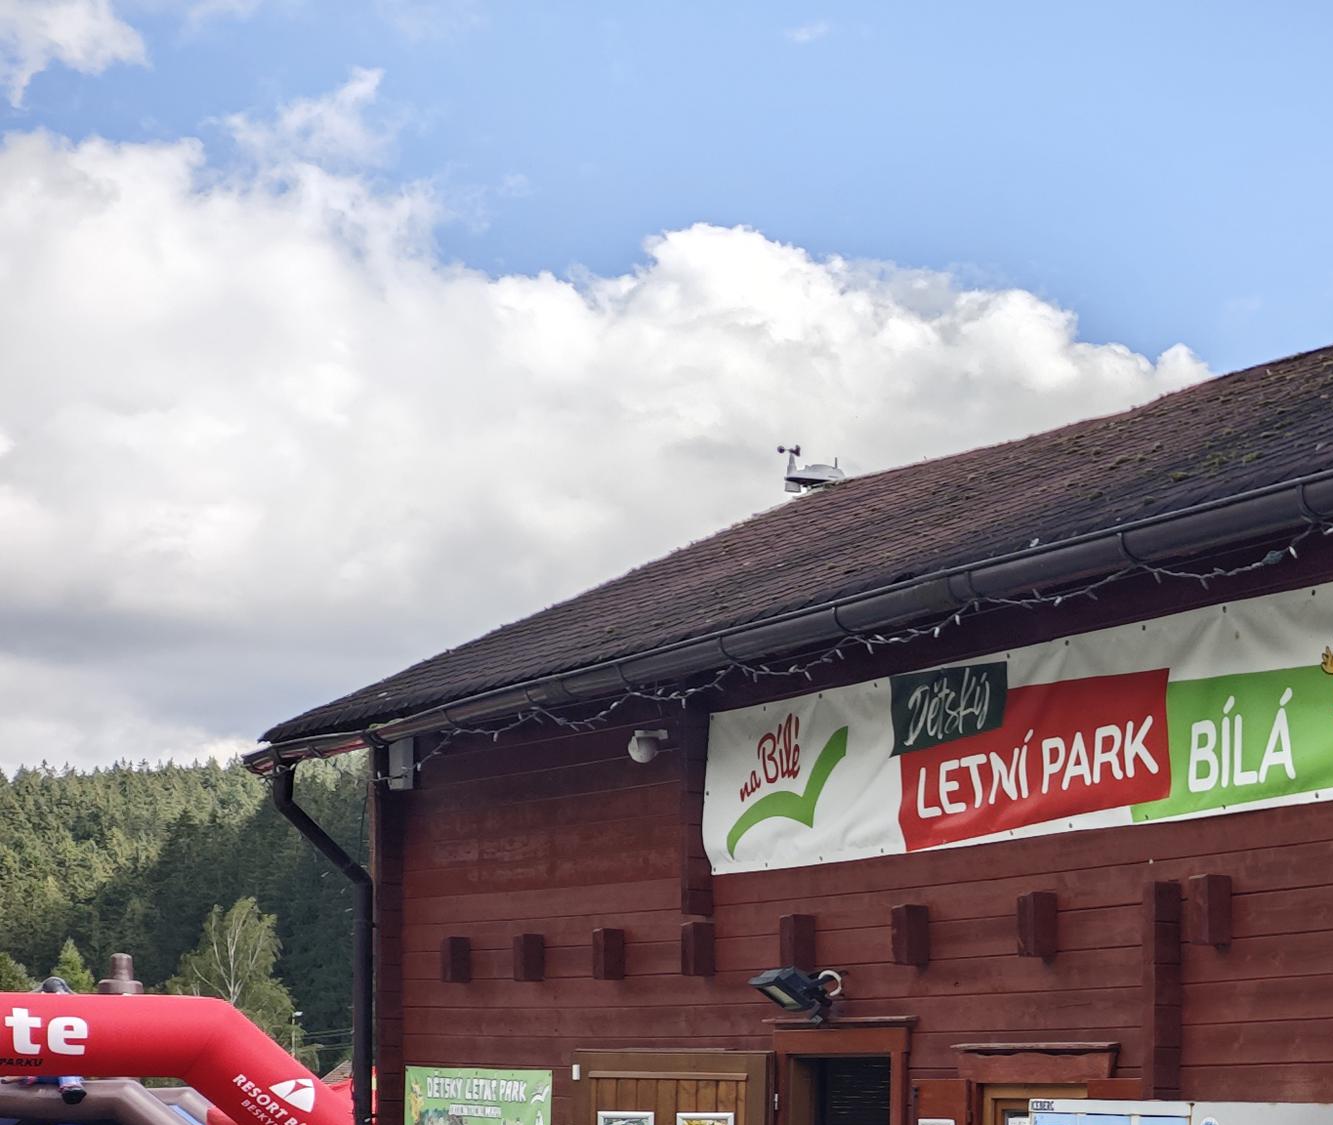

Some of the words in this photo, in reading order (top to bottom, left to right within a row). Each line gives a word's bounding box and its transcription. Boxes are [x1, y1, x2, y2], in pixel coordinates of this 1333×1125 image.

[904, 667, 990, 746] Dětský
[740, 775, 761, 802] na
[758, 713, 801, 783] Bílé
[916, 729, 1034, 819] LETNÍ
[1041, 715, 1159, 794] PARK
[1187, 687, 1296, 793] BÍLÁ
[5, 1007, 88, 1055] te
[233, 1073, 287, 1118] RESORT
[500, 1079, 527, 1102] PARK
